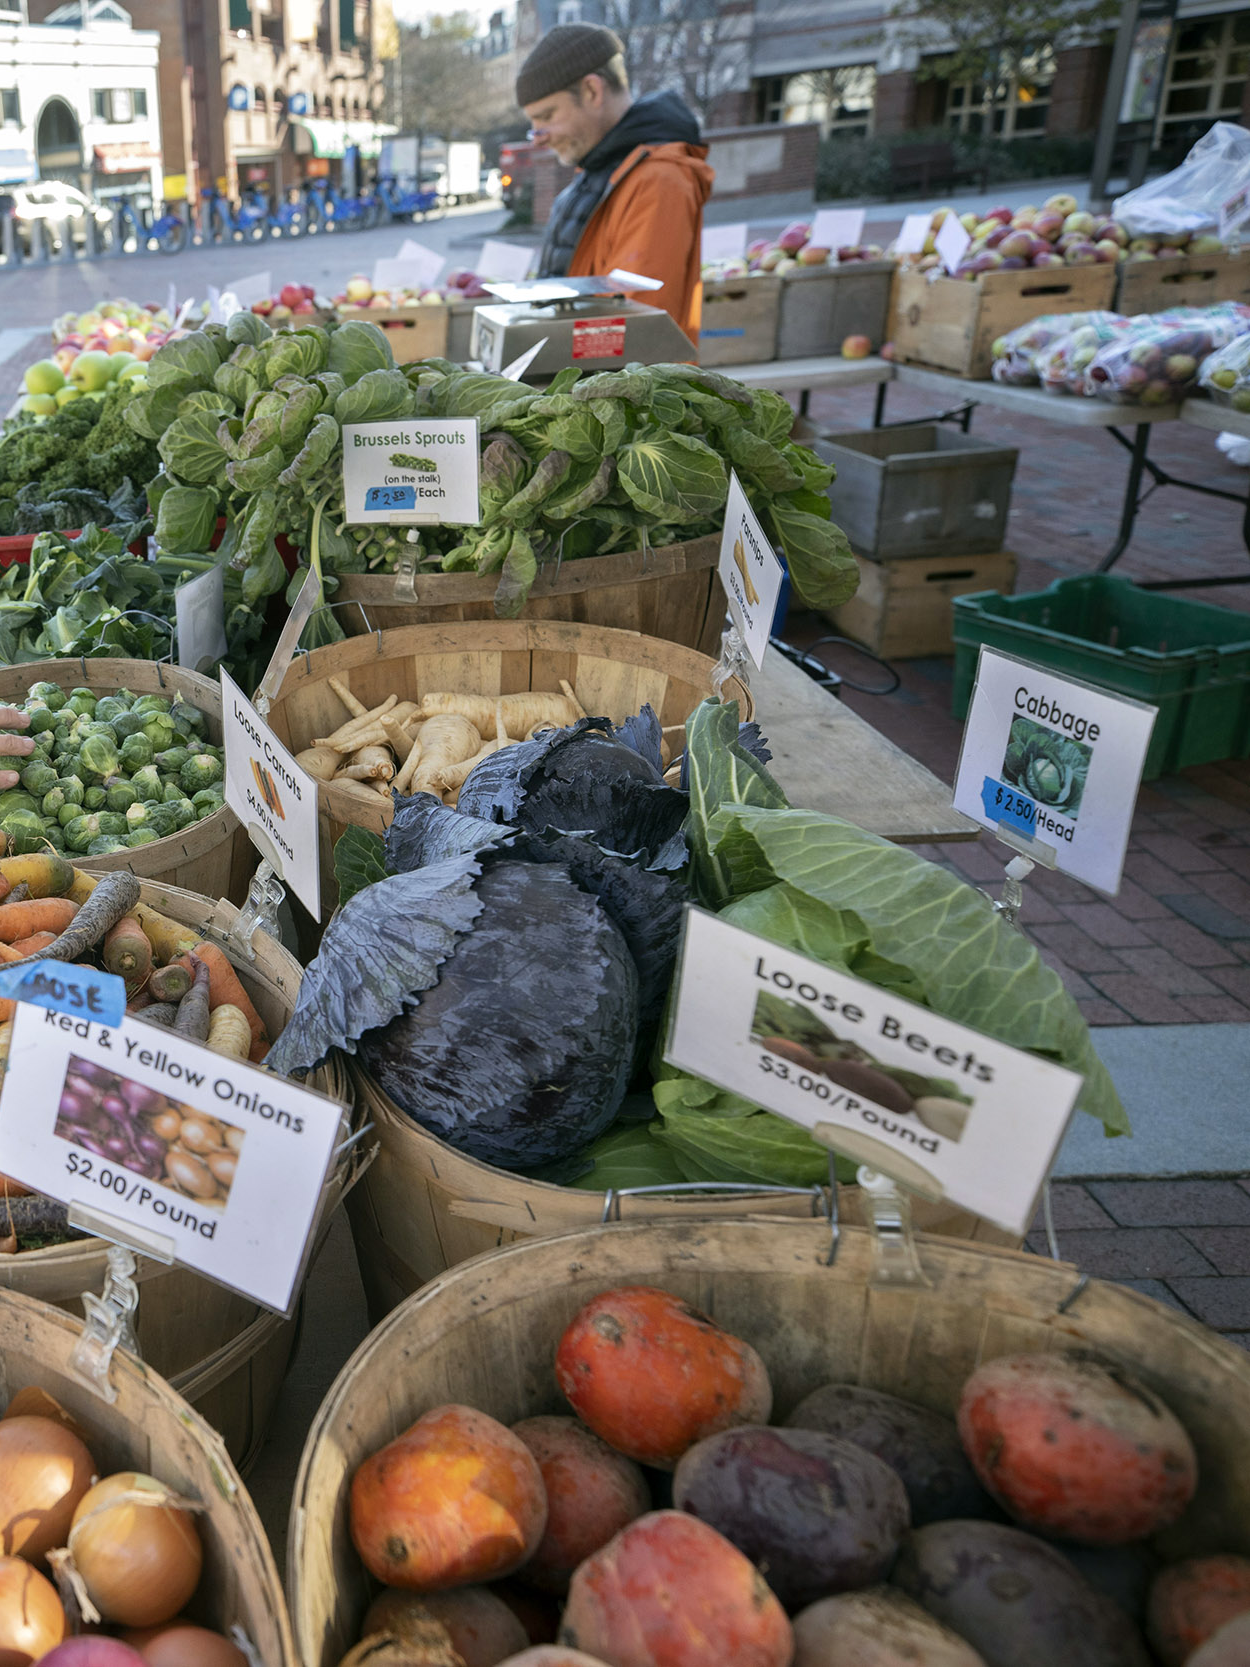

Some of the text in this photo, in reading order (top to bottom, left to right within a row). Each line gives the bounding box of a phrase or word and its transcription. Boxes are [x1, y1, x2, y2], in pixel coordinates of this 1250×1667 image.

[353, 431, 466, 447] Brussels Sprouts
[384, 474, 441, 485] (on the stalk)
[741, 512, 764, 567] Parsnips
[234, 700, 301, 801] Loose Carrots
[1014, 687, 1100, 741] Cabbage
[246, 788, 294, 861] $4.00/Pound
[754, 957, 995, 1084] Loose Beets
[44, 1008, 305, 1134] Red & Yellow Onions
[758, 1054, 941, 1154] $3.00/Pound
[65, 1152, 218, 1240] $2.00/Pound
